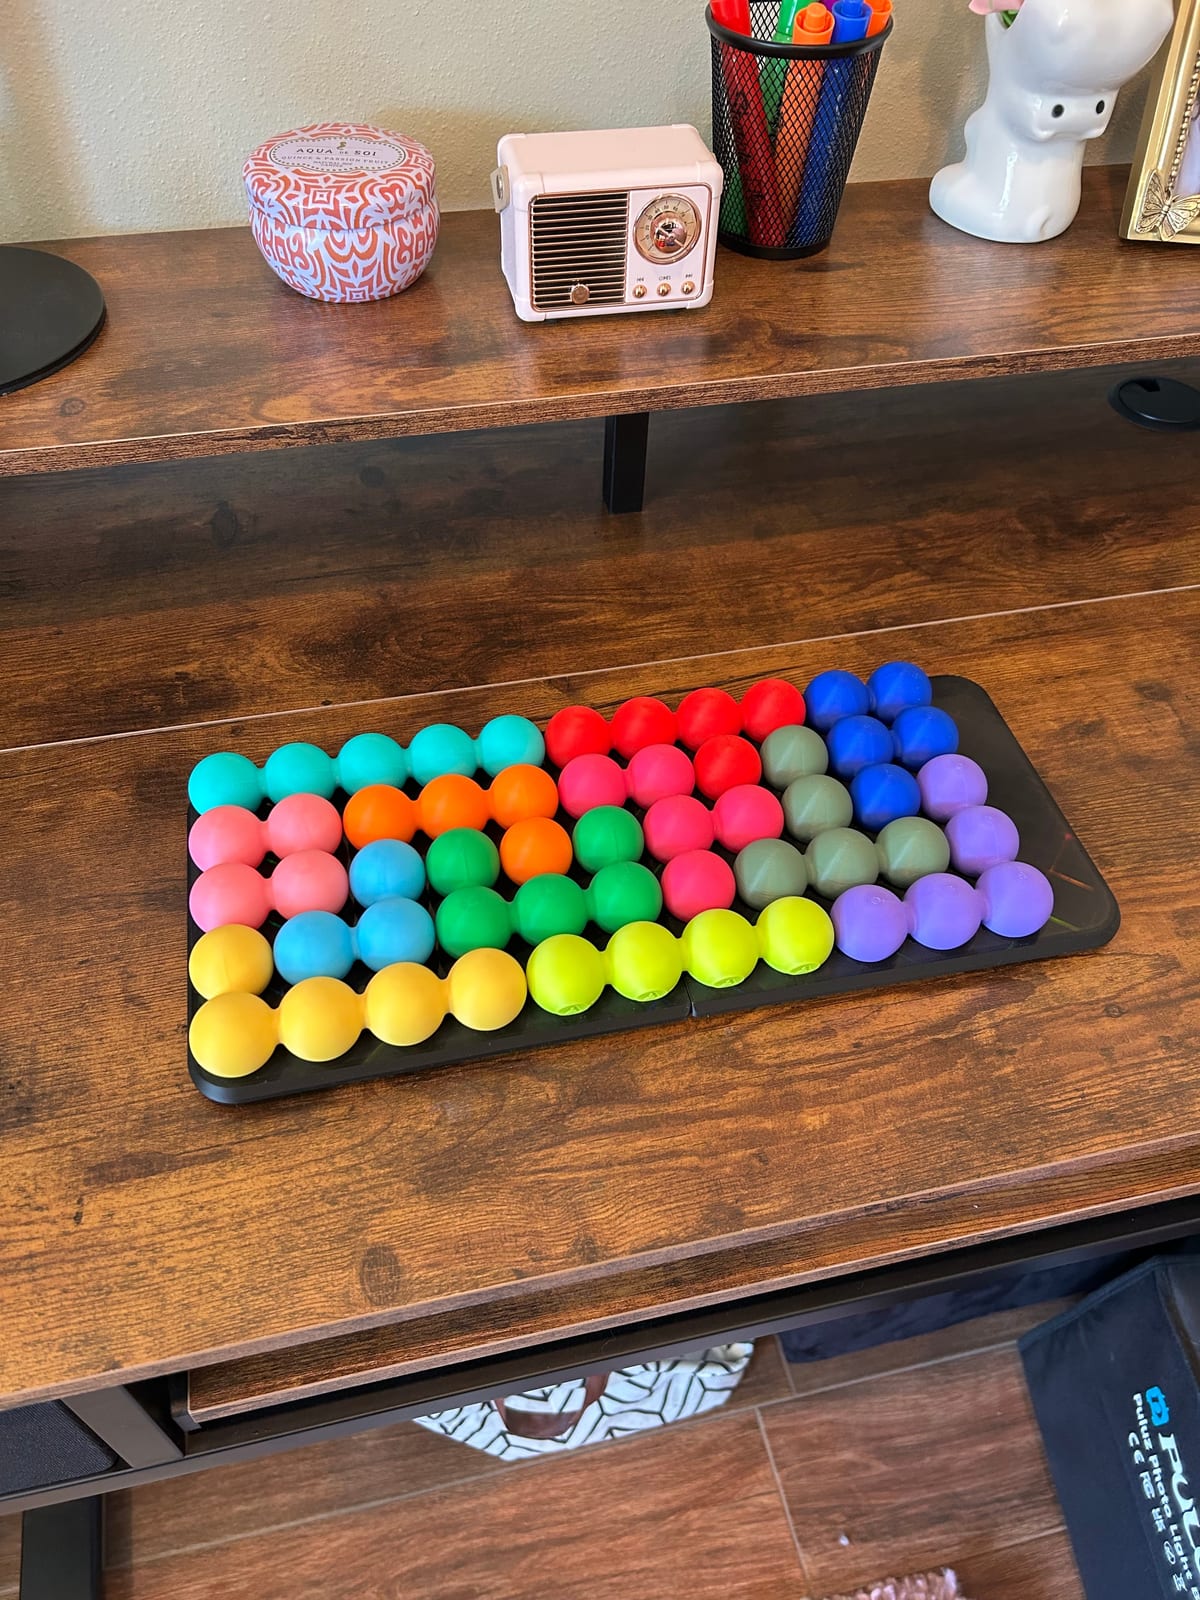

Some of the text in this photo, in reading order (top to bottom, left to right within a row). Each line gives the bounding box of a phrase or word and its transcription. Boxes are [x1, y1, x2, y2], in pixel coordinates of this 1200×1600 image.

[1133, 1393, 1153, 1451] Puluz
[1149, 1454, 1172, 1518] Photo
[1169, 1524, 1193, 1580] Light
